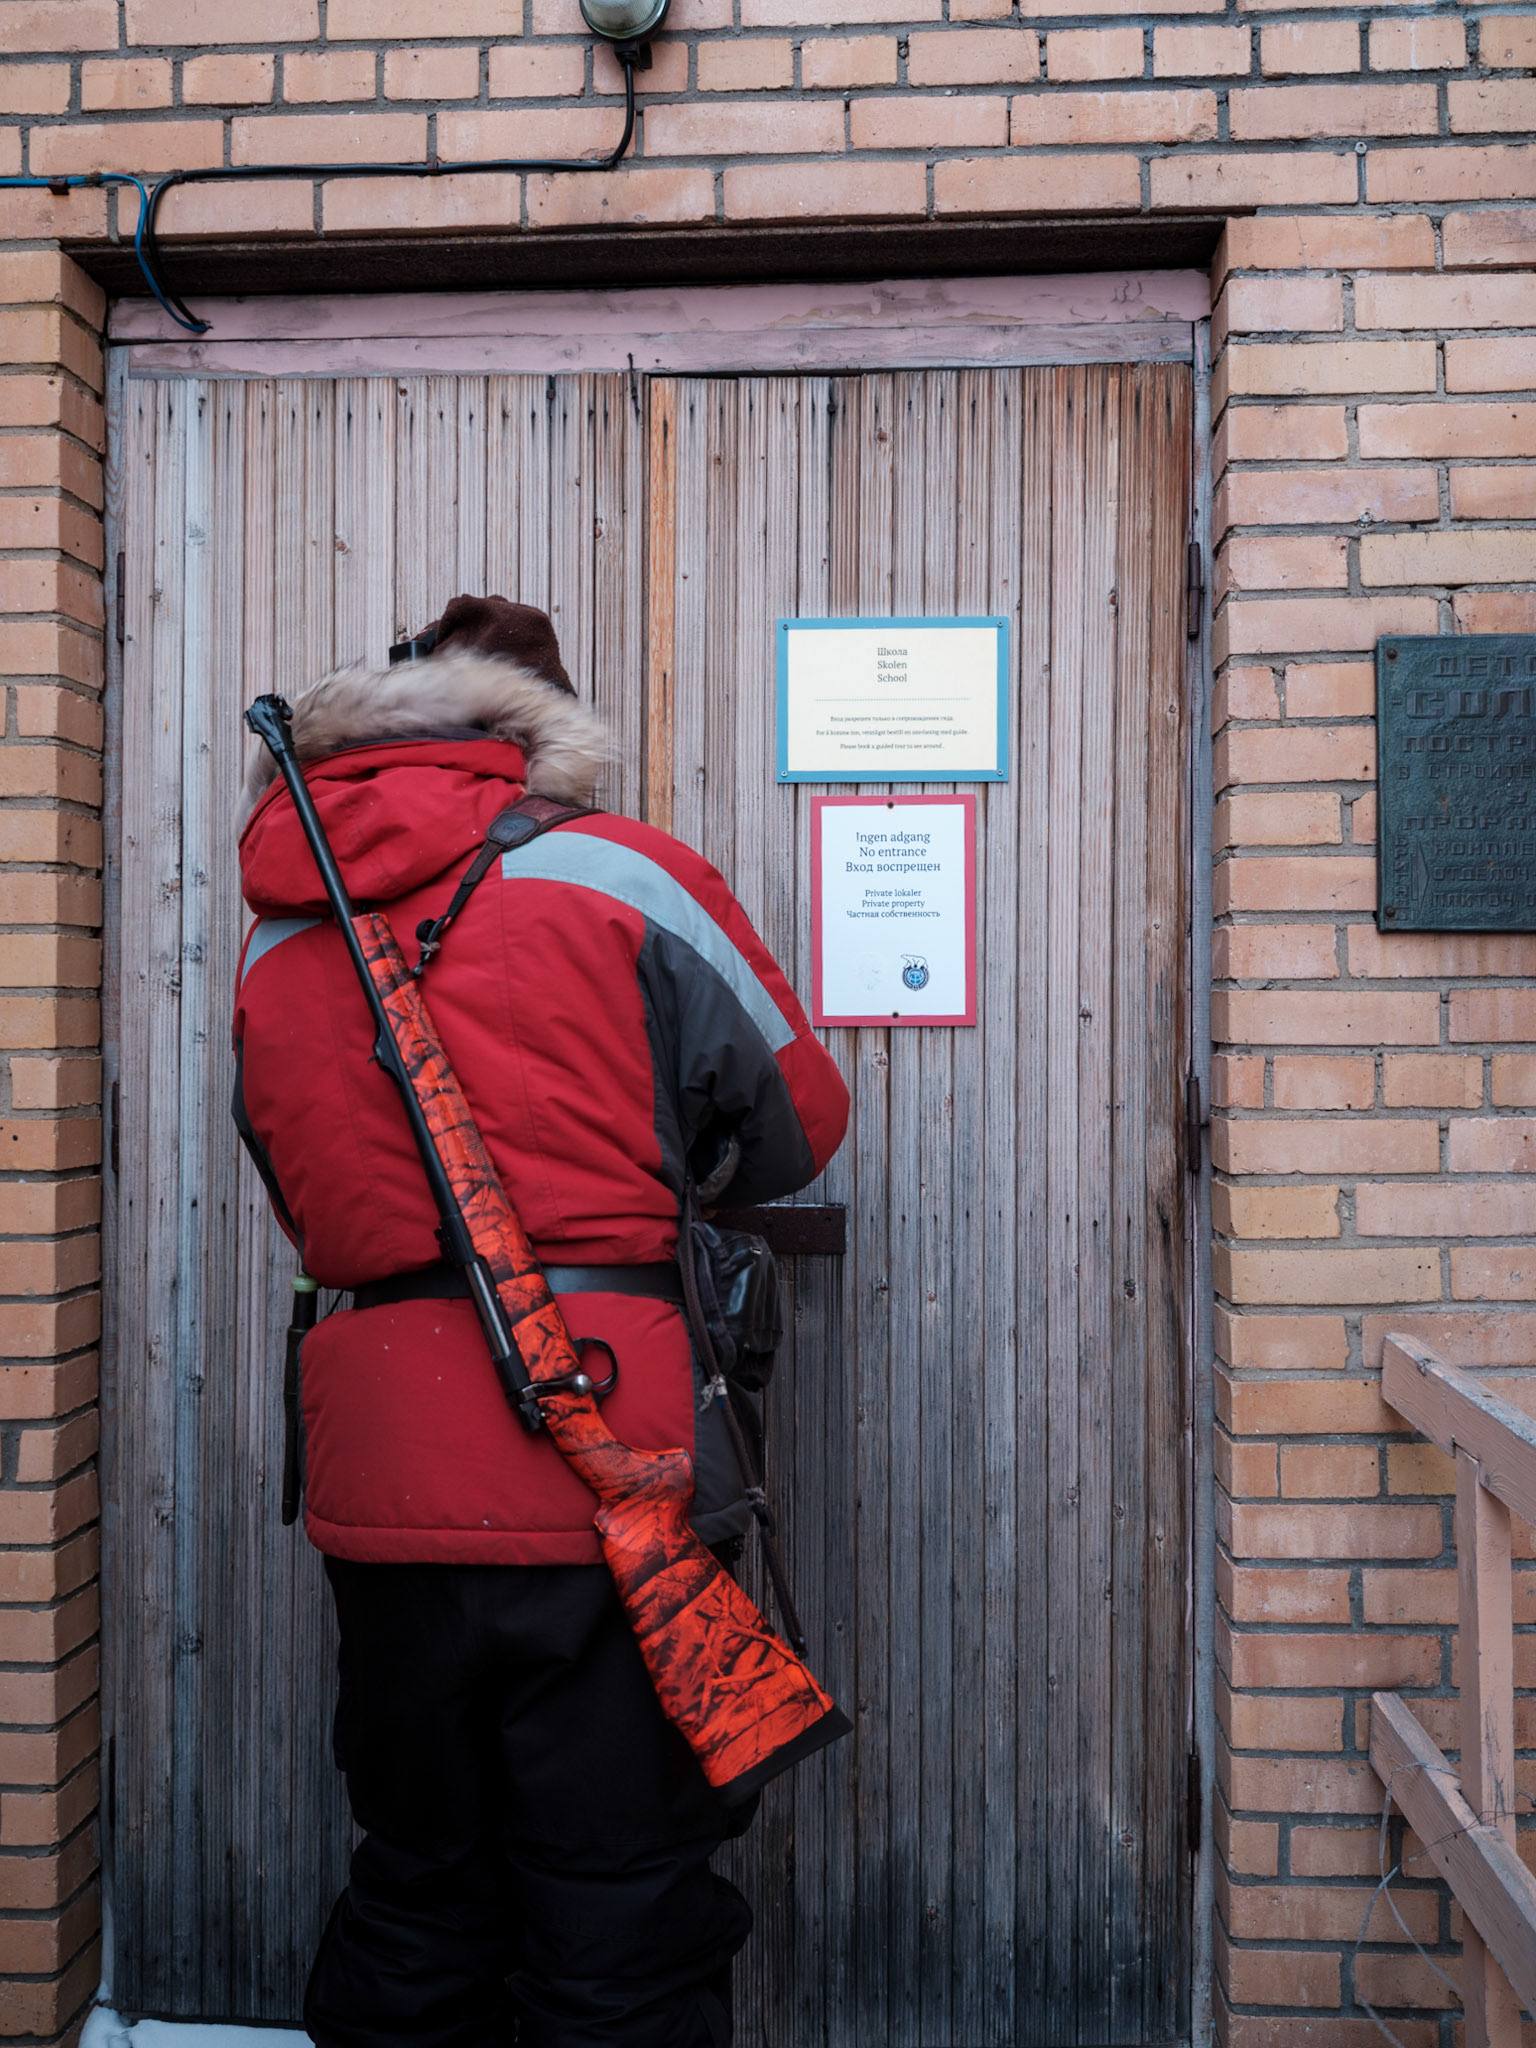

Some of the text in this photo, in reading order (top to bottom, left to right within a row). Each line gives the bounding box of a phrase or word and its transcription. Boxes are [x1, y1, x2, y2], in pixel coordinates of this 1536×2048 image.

[877, 647, 909, 657] Школа
[877, 660, 908, 669] Skolen
[877, 673, 908, 682] School
[876, 743, 894, 751] guided
[1402, 734, 1536, 753] ПОСТР
[1401, 815, 1536, 831] ПРОРА
[856, 831, 931, 845] Ingen adgang
[859, 847, 927, 857] No entrance
[846, 862, 941, 874] Вход воспрещен
[865, 889, 921, 897] Private lokaler
[862, 899, 925, 909] Private property
[846, 909, 941, 918] Частная собственность
